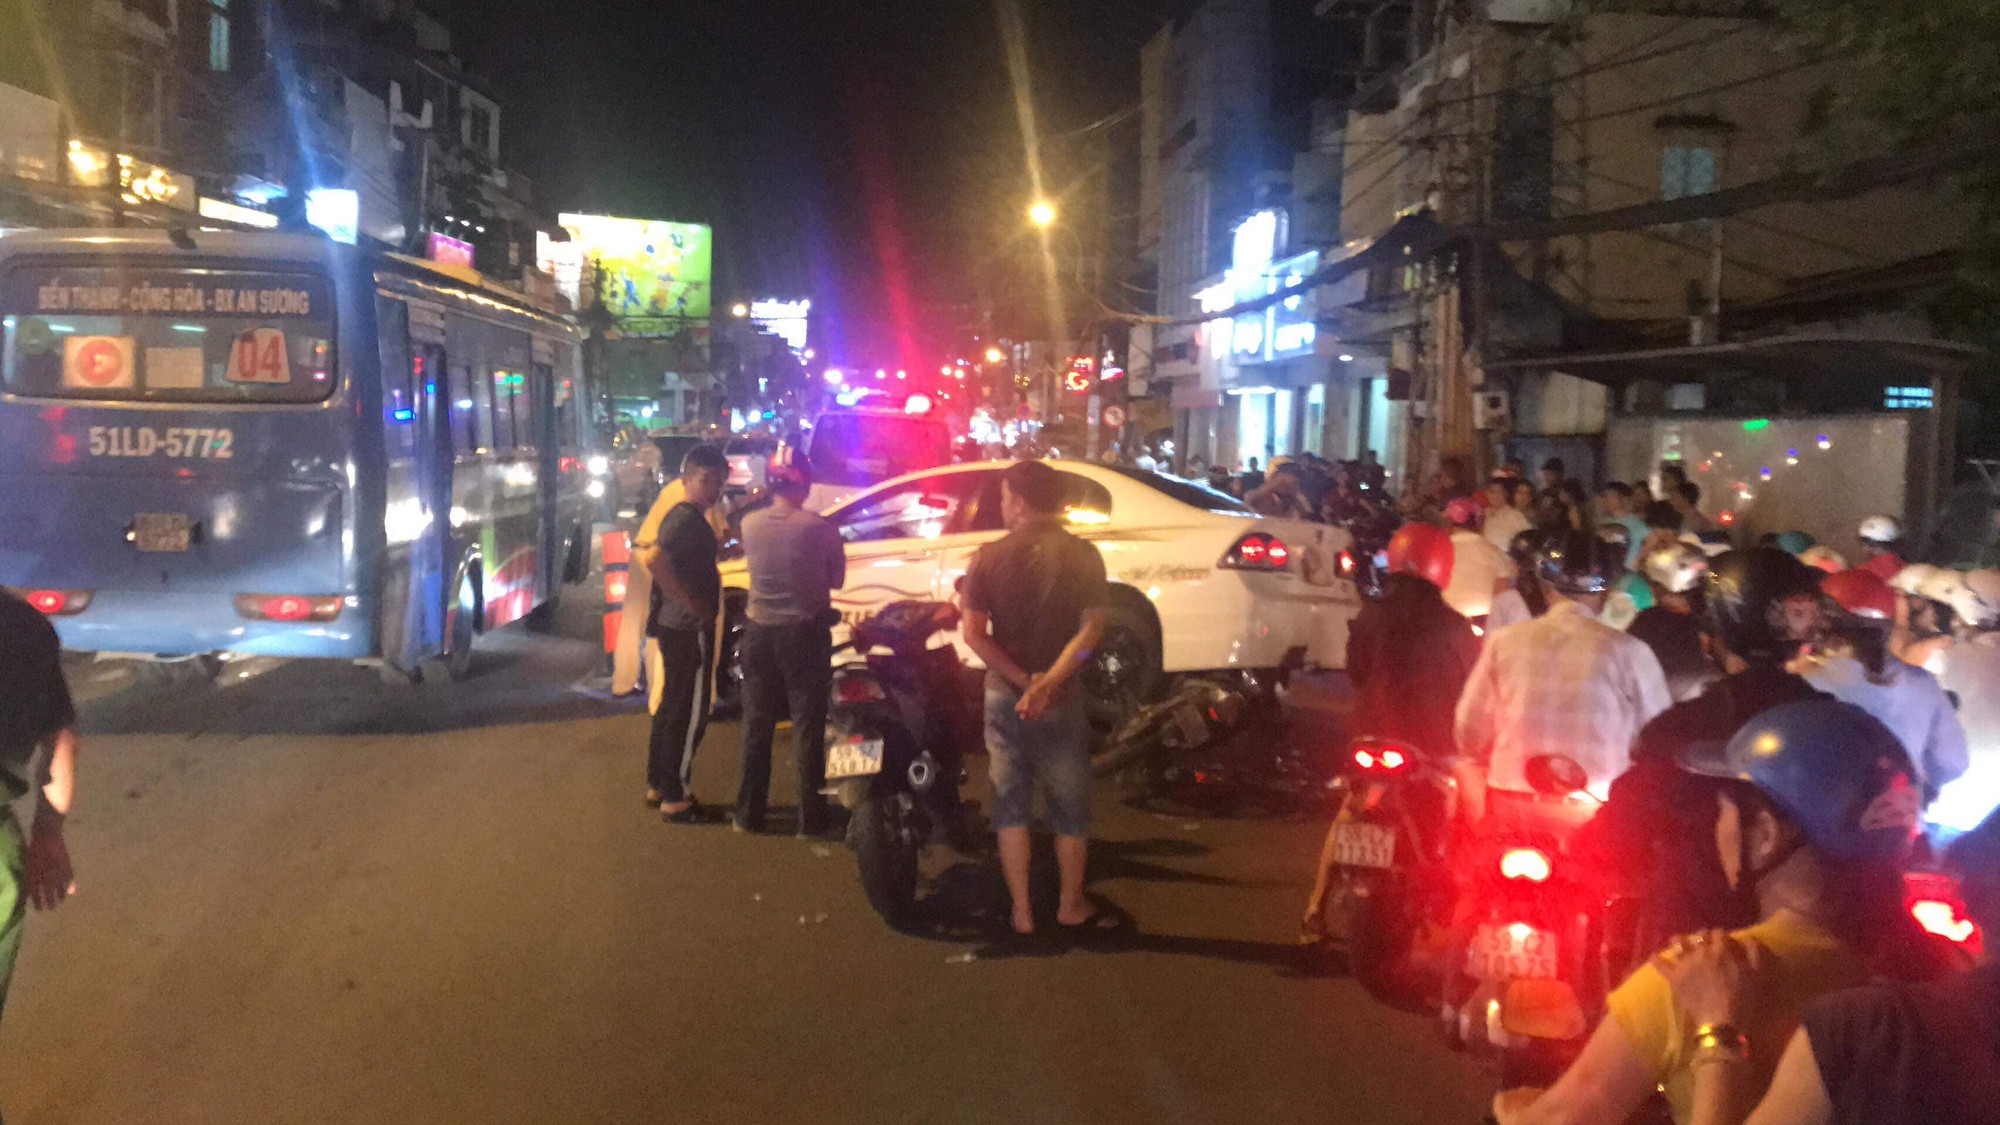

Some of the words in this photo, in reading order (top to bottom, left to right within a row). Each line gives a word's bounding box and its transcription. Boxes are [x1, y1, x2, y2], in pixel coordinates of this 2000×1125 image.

[238, 288, 258, 313] AN
[237, 334, 283, 380] 04
[88, 426, 234, 459] 51LD-5772
